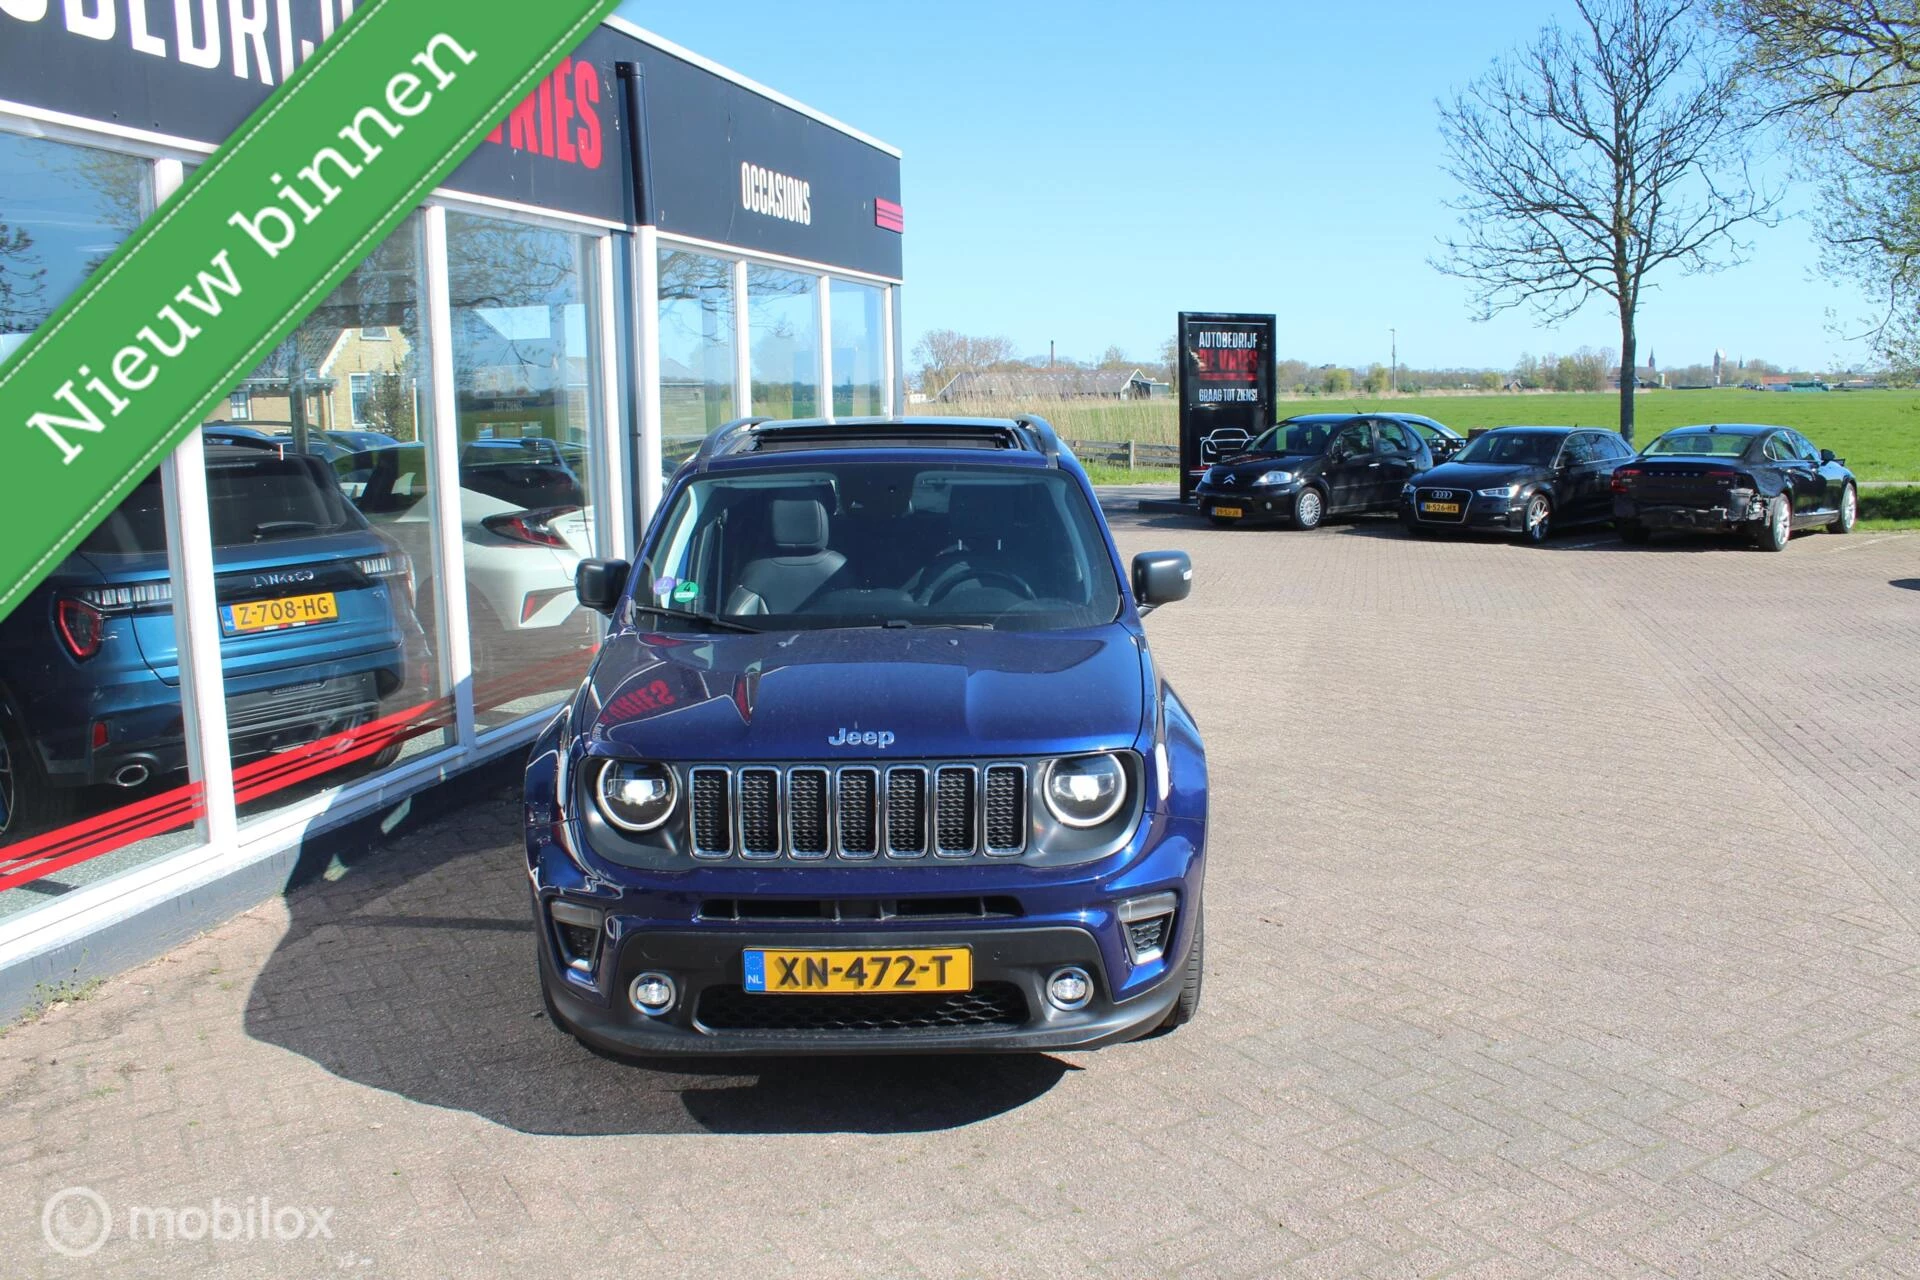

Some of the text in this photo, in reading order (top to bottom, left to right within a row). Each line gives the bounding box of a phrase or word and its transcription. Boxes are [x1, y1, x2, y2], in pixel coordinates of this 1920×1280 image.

[485, 55, 602, 170] RIES
[741, 161, 811, 226] OCCASIONS
[1199, 331, 1258, 349] AUTOBEDRIJF
[1199, 388, 1222, 402] GRAAG
[1223, 388, 1236, 402] TOT
[239, 597, 330, 626] Z-708-HG
[828, 727, 895, 749] Jeep
[747, 974, 763, 985] NL
[777, 955, 953, 987] XN-472-T
